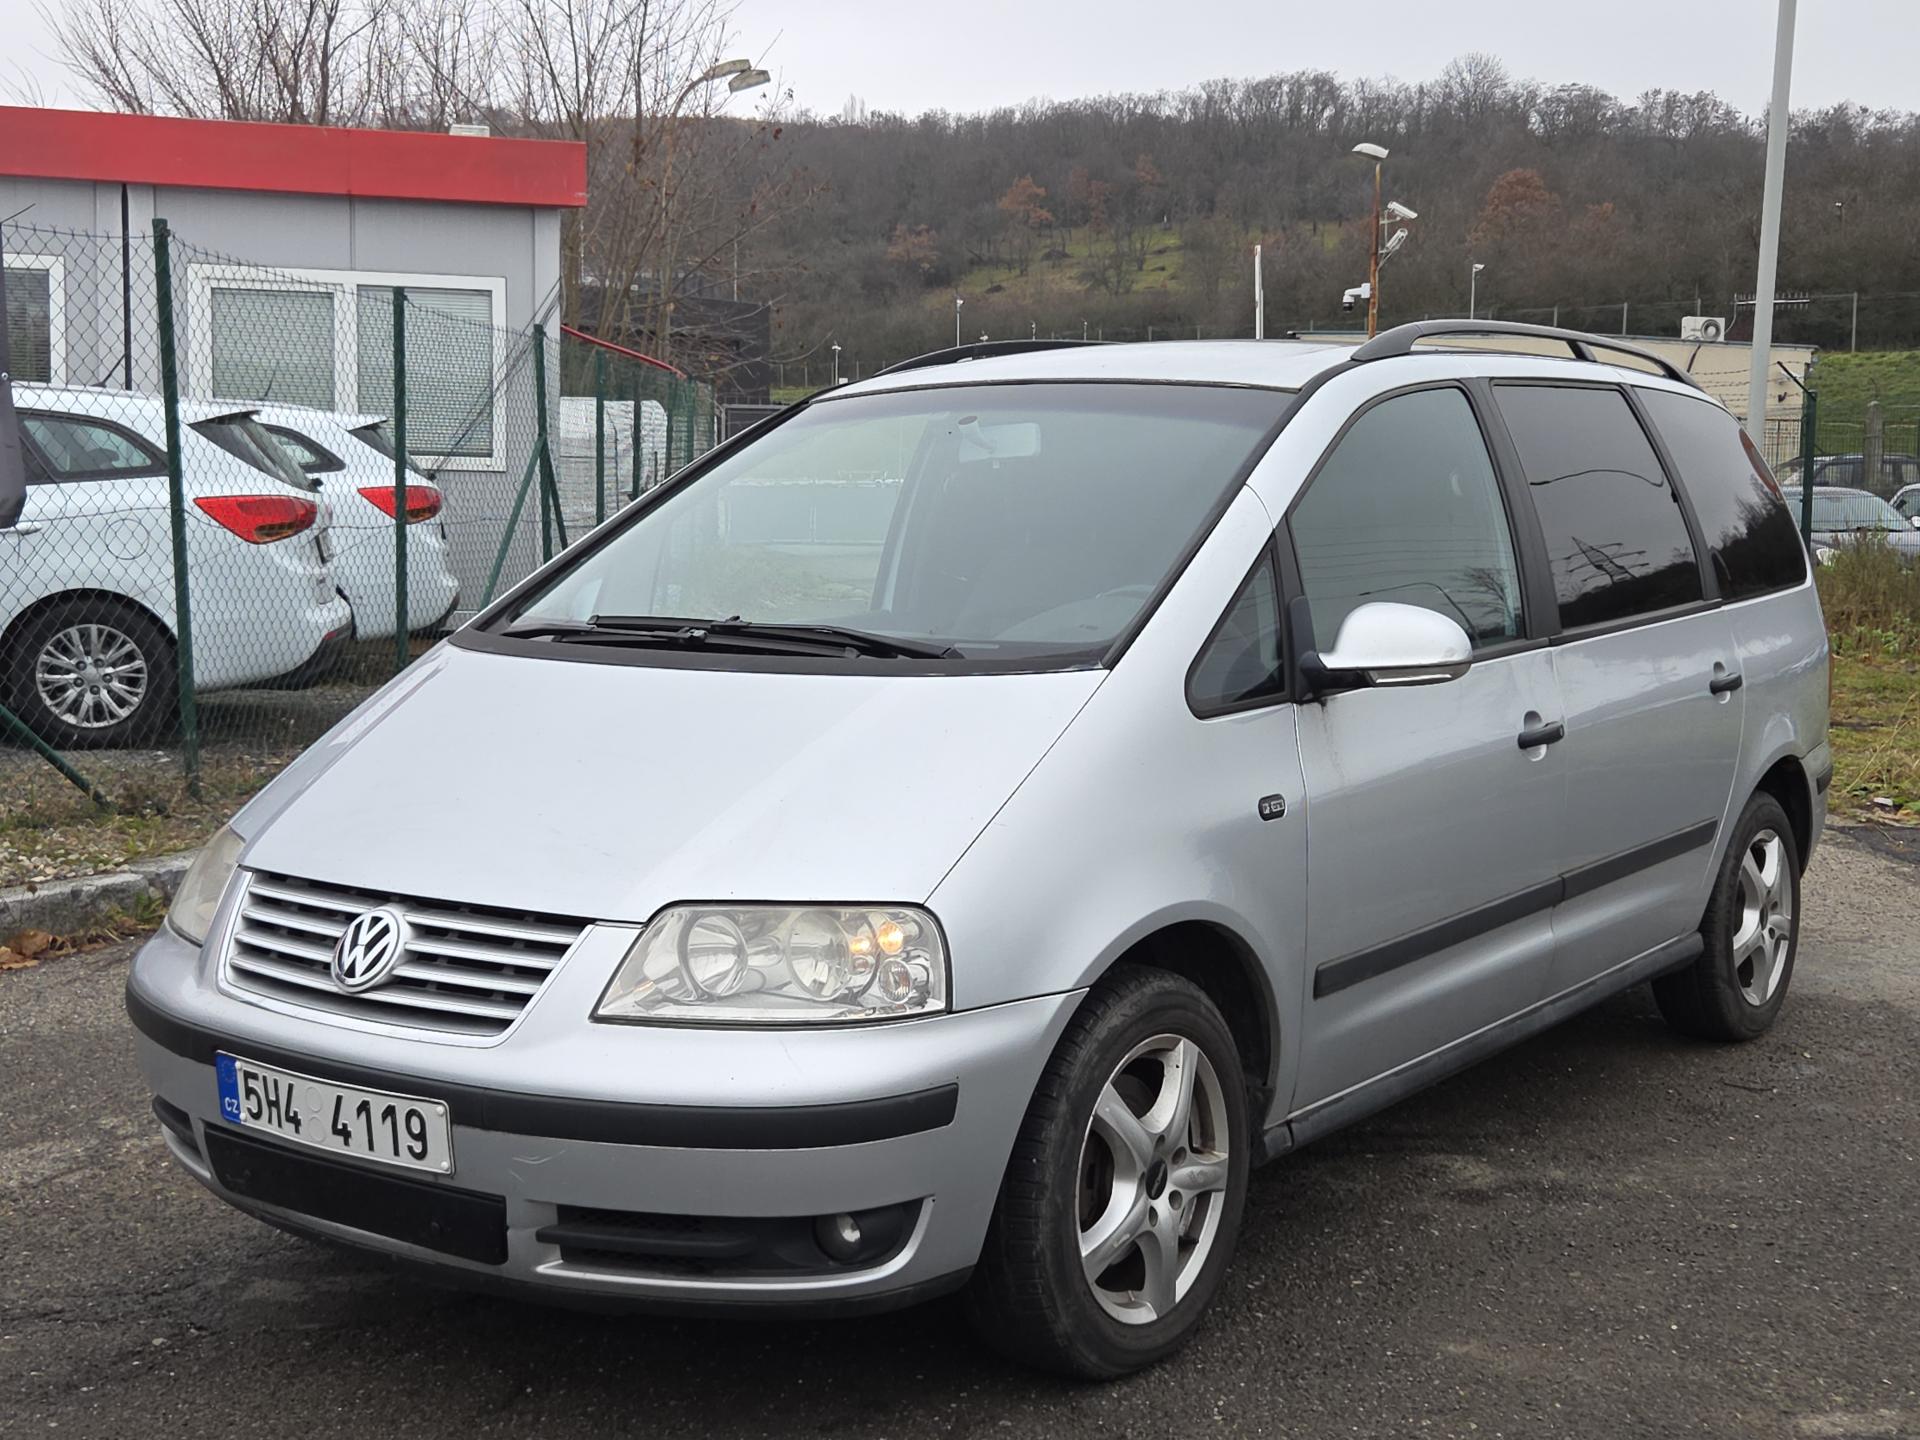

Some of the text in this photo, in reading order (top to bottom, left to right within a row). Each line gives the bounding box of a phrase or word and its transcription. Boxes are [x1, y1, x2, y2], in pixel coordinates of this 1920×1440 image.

[338, 909, 398, 985] VW
[224, 1096, 239, 1114] CZ
[243, 1069, 428, 1161] 5H4 4119
